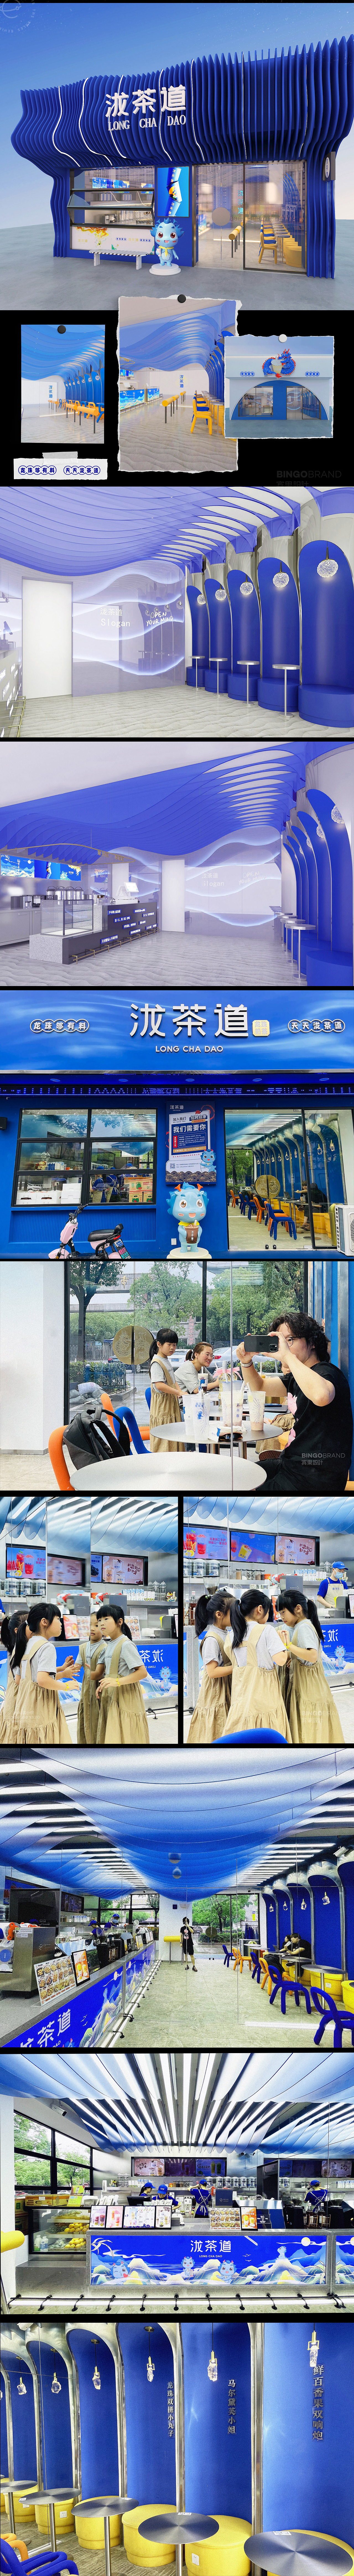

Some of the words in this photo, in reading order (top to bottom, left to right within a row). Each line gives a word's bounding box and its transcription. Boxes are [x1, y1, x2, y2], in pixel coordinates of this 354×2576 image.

[105, 84, 186, 117] 泷茶道
[108, 120, 130, 131] LONG
[139, 118, 157, 128] CHA
[167, 115, 186, 126] DAO
[100, 608, 123, 616] 泷茶道
[101, 618, 130, 628] Slogan
[146, 618, 159, 626] YOUR
[130, 1003, 249, 1037] 泷茶道
[291, 1021, 342, 1030] 天天泷茶道
[33, 1022, 86, 1030] 龙珠够有料
[173, 1124, 206, 1133] 我们需要你
[191, 2240, 231, 2252] 泷茶道
[228, 2379, 236, 2434] 马尔黛芙小姐
[313, 2365, 324, 2440] 鲜百香果双响炮
